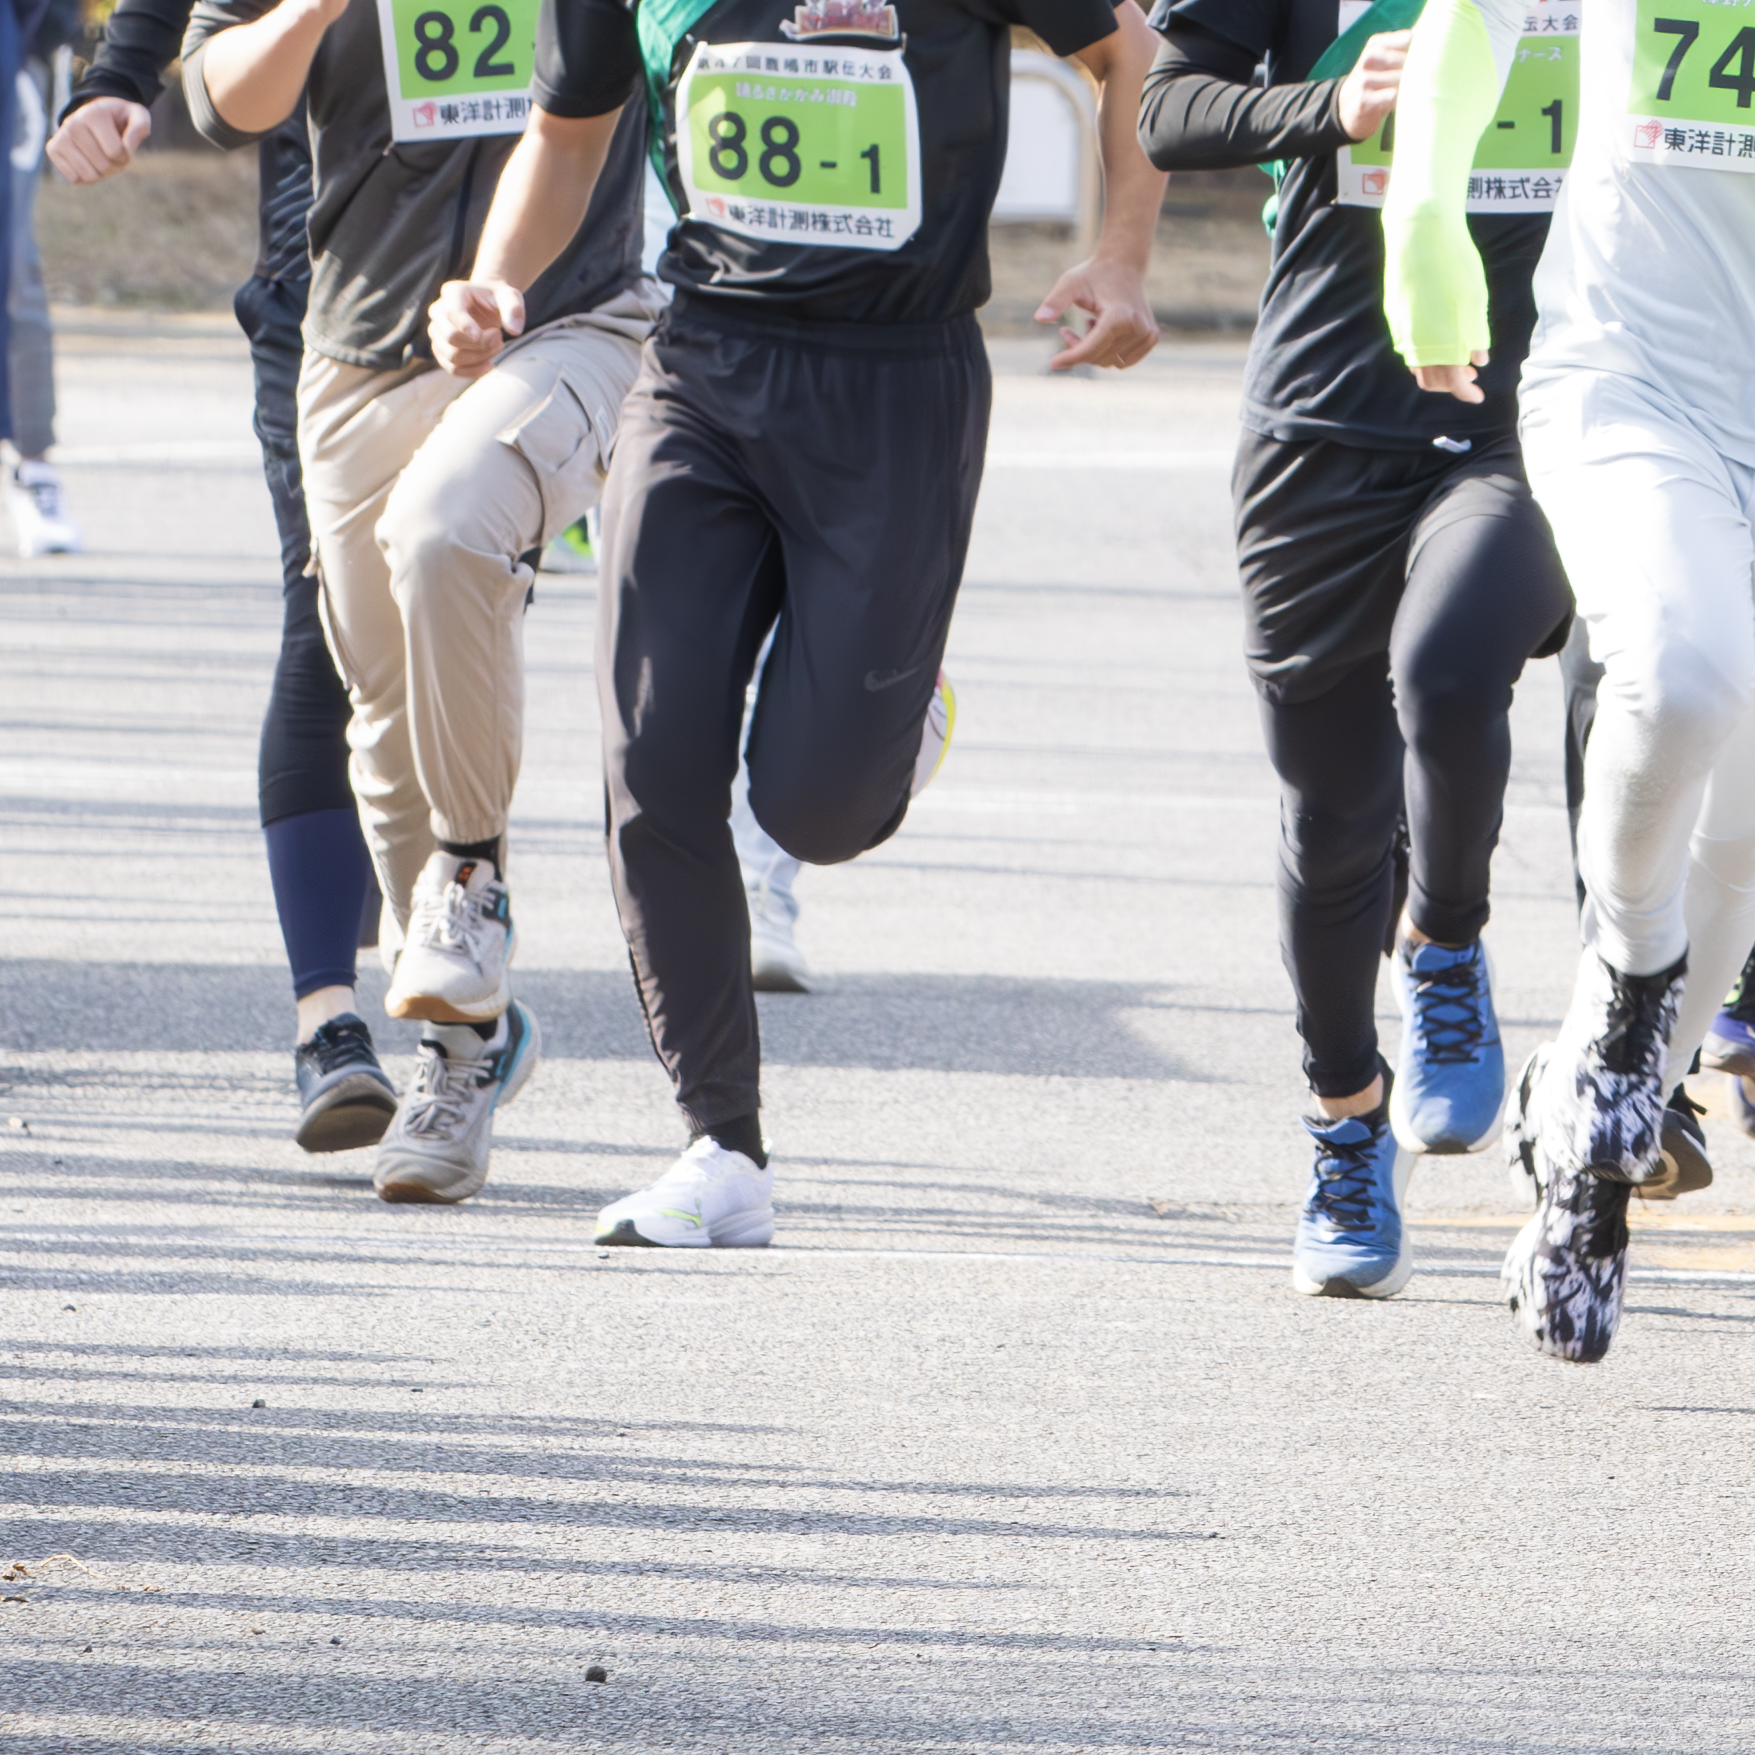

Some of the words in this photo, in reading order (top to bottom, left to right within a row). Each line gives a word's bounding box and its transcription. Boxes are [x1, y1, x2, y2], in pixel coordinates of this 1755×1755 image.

[440, 98, 531, 125] 東洋計測
[729, 203, 895, 239] 東洋計測株式会社
